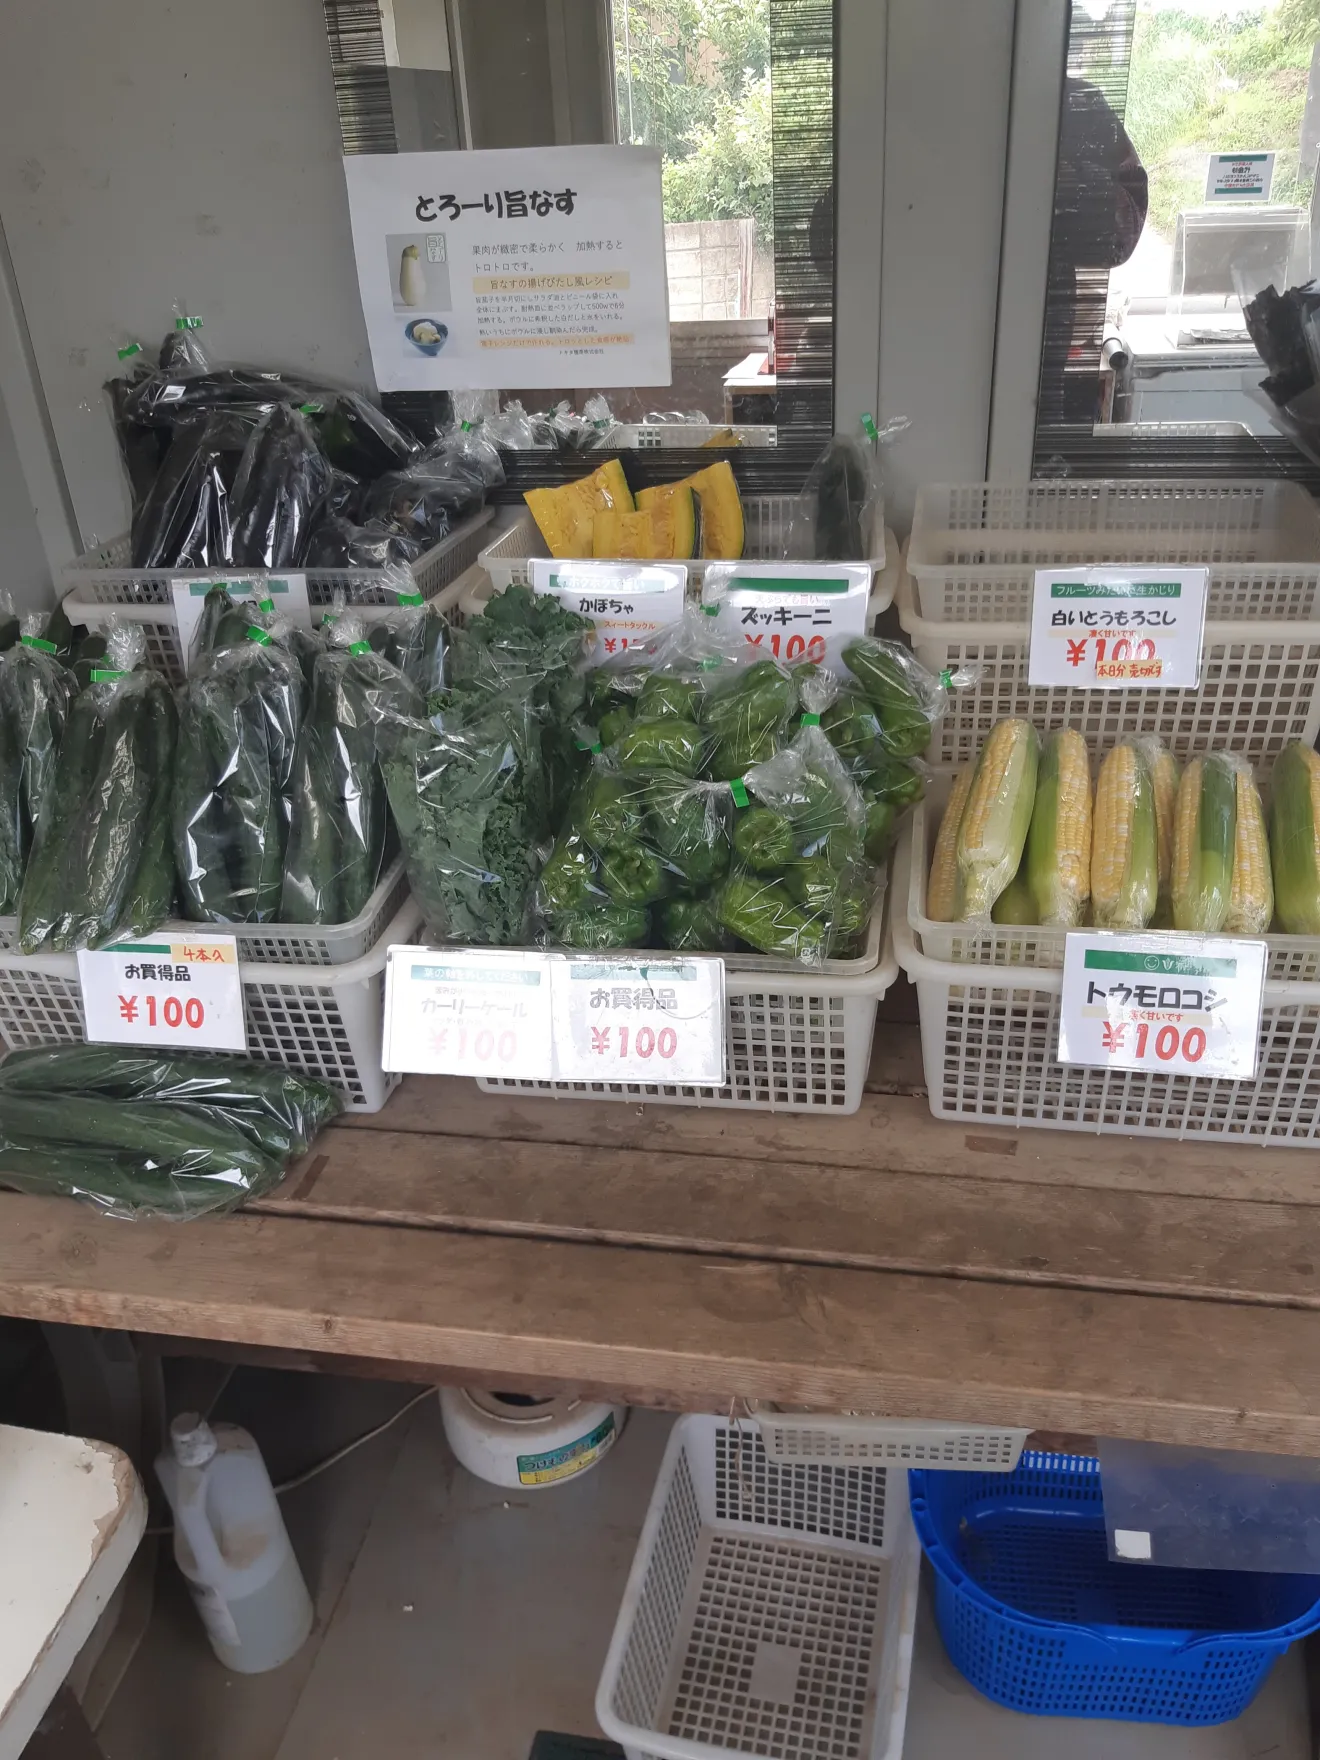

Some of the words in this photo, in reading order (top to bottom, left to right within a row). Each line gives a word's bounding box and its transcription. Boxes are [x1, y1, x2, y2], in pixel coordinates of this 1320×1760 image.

[415, 188, 578, 223] とろーり旨なす
[575, 240, 623, 254] 加熱すると
[475, 262, 534, 274] トロトロです。
[579, 597, 634, 614] かぼちゃ
[741, 607, 832, 626] ズッキーニ
[1051, 609, 1177, 626] 白いとうもろこし
[125, 963, 191, 982] お買得品
[589, 987, 678, 1010] お買得品
[1086, 981, 1228, 1012] トウモロコシ
[117, 995, 205, 1029] ¥100
[590, 1026, 678, 1059] ¥100
[1101, 1021, 1207, 1063] ¥100
